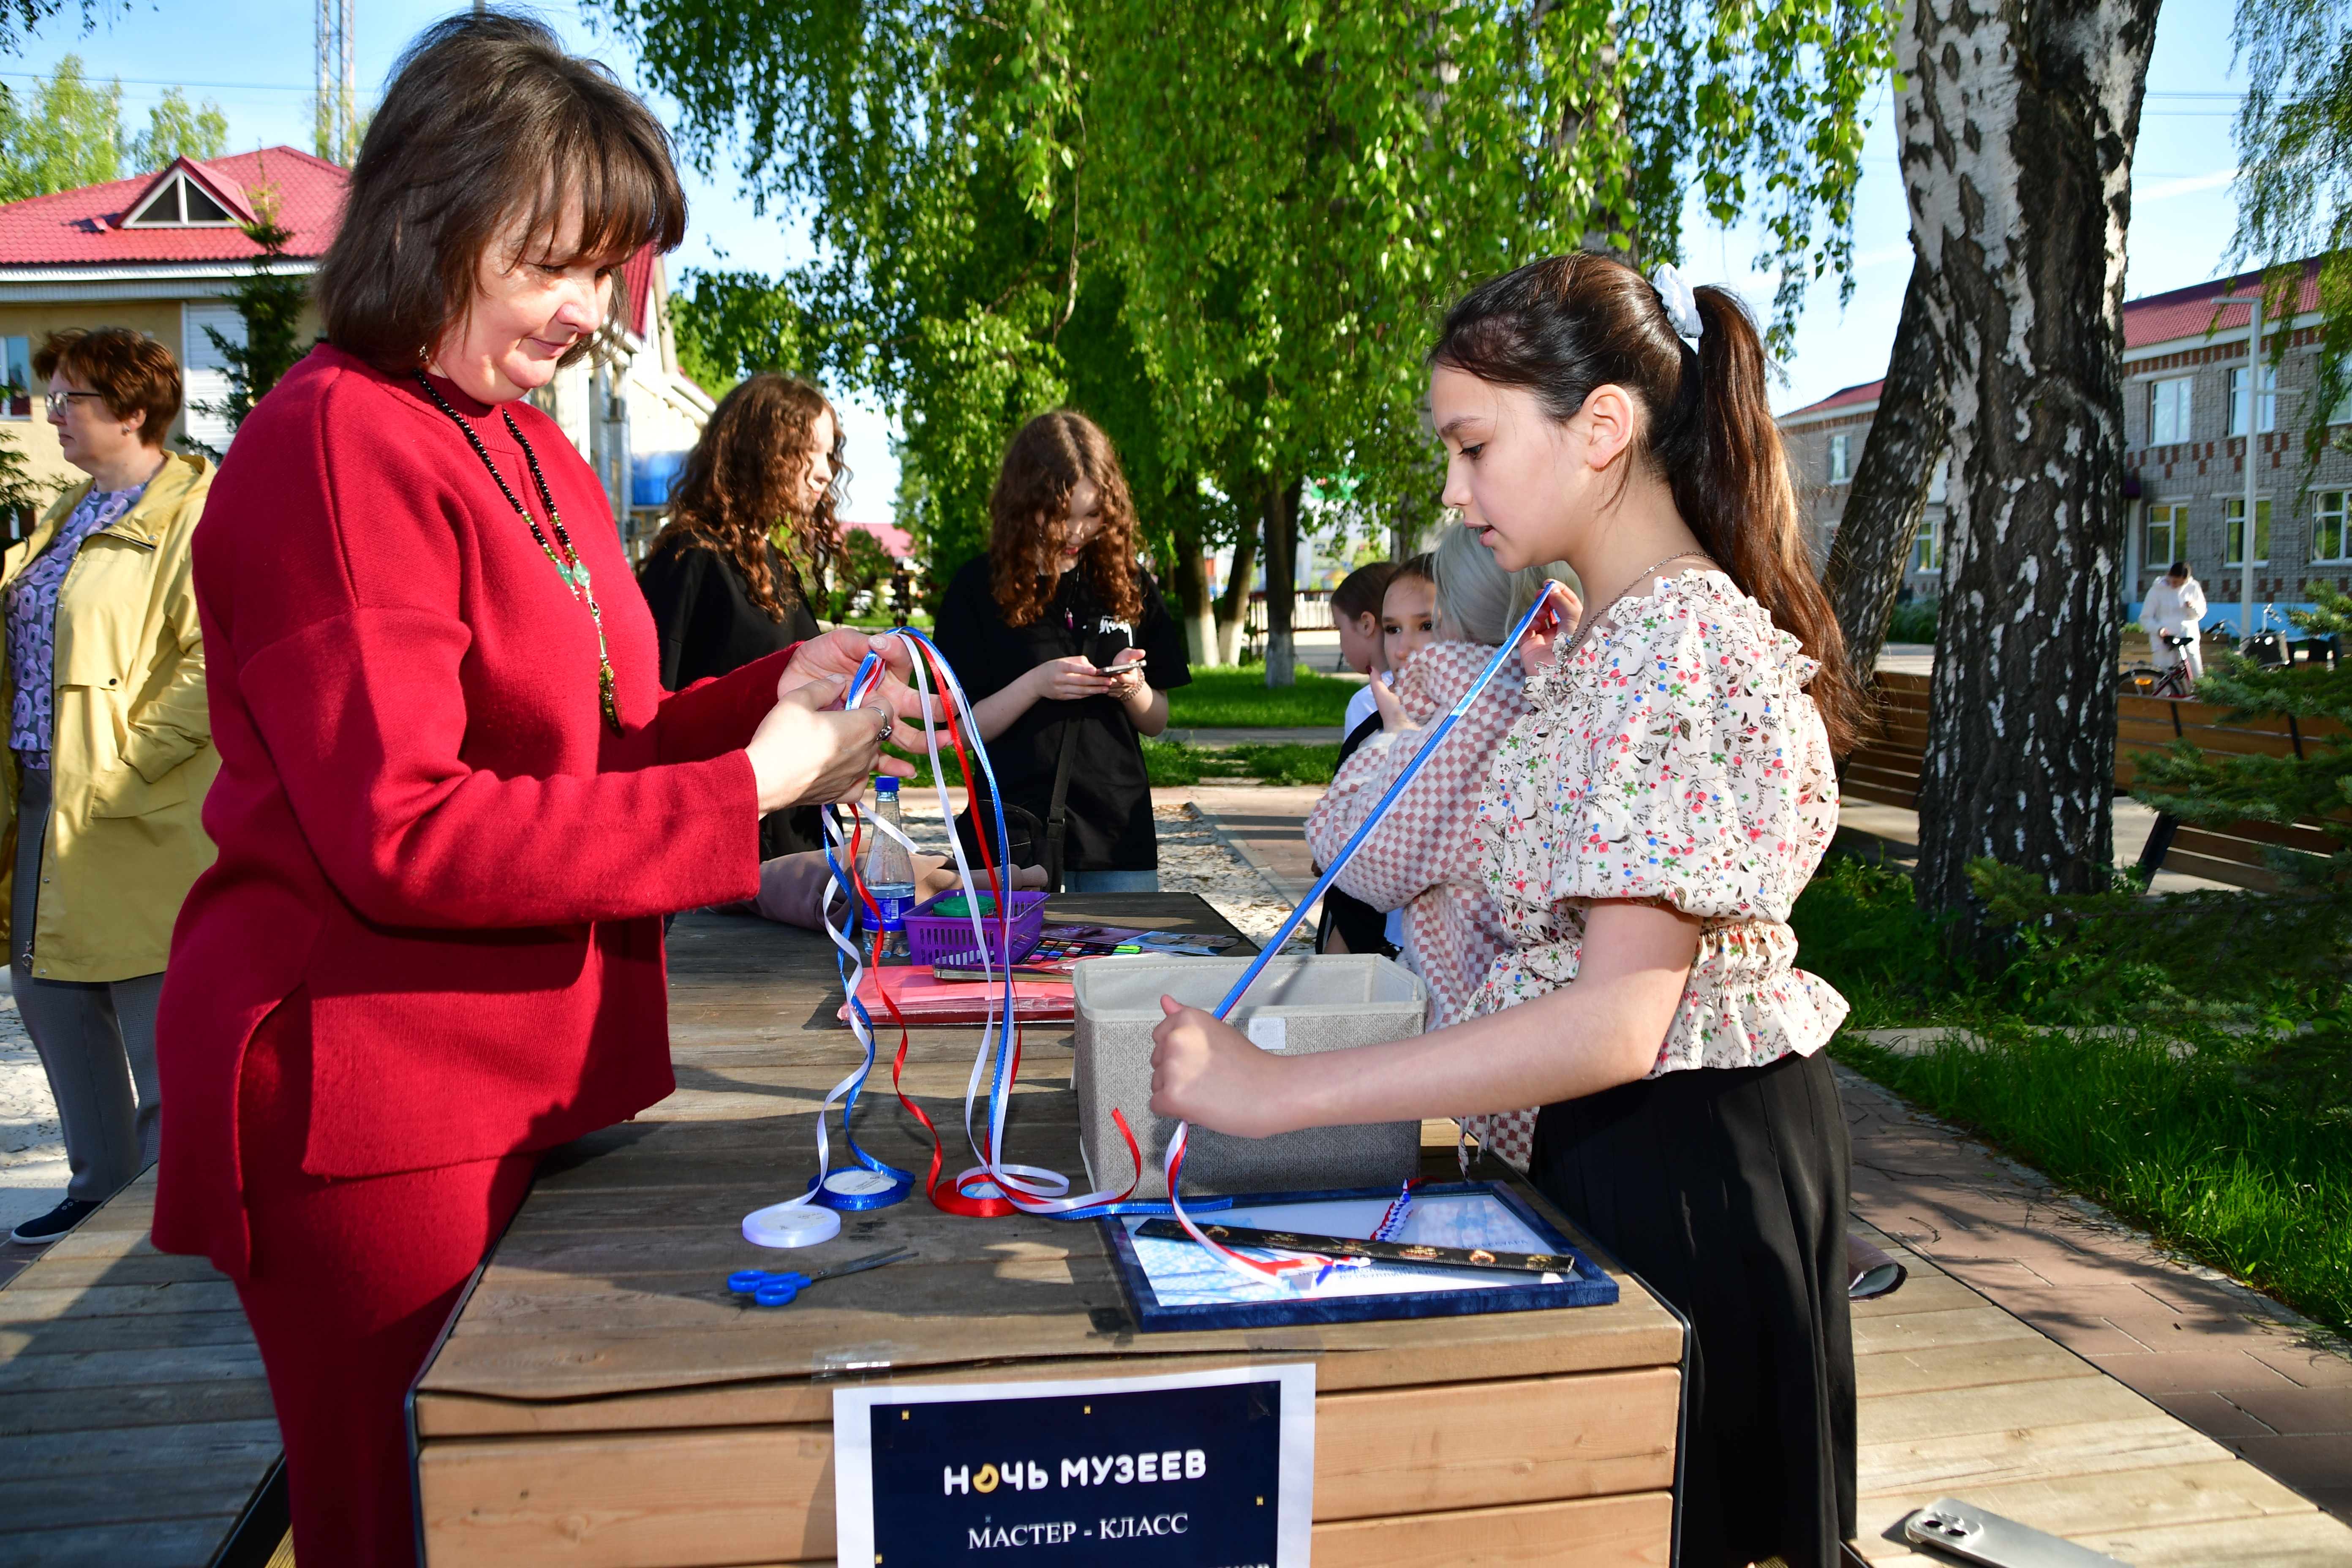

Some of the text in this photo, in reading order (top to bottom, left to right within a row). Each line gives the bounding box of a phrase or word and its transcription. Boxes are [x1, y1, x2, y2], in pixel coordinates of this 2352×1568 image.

[944, 1449, 1206, 1495] НОЧЬ МУЗЕЕВ
[968, 1522, 1076, 1549] МАСТЕР
[1100, 1513, 1187, 1539] КЛАСС
